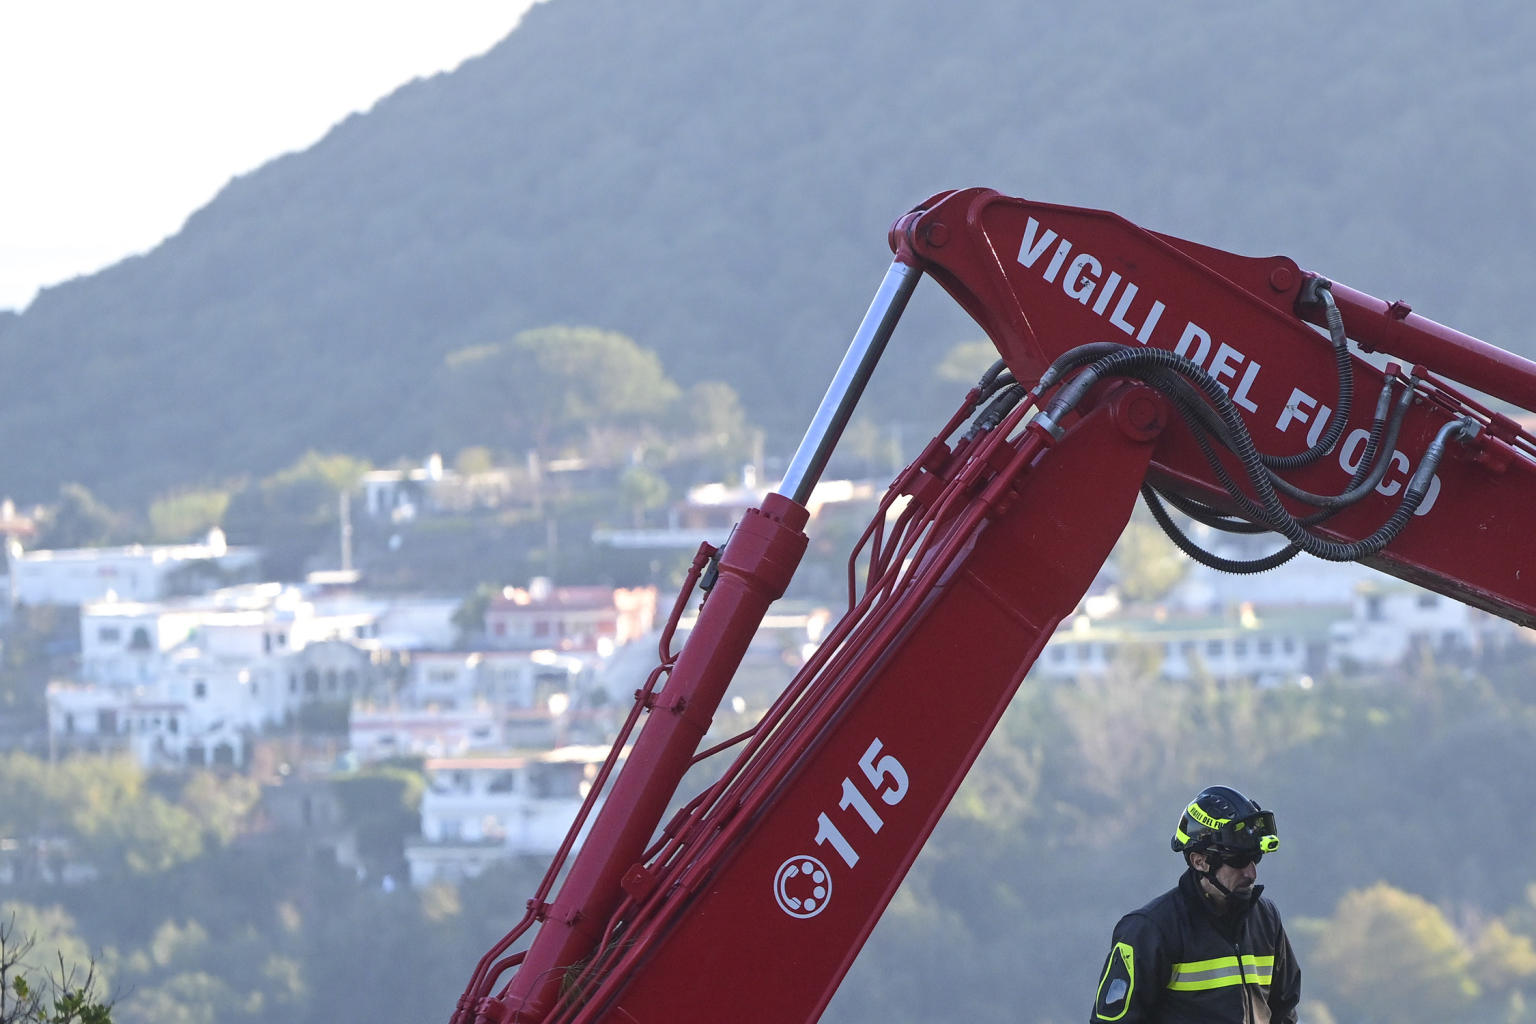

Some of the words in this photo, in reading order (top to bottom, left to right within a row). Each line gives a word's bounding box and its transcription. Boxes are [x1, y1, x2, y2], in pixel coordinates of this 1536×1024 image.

[1016, 215, 1166, 345] VIGILI
[1174, 321, 1262, 414] DEL
[1275, 387, 1441, 516] FUOCO
[814, 737, 909, 869] 115
[1202, 816, 1213, 826] DEL
